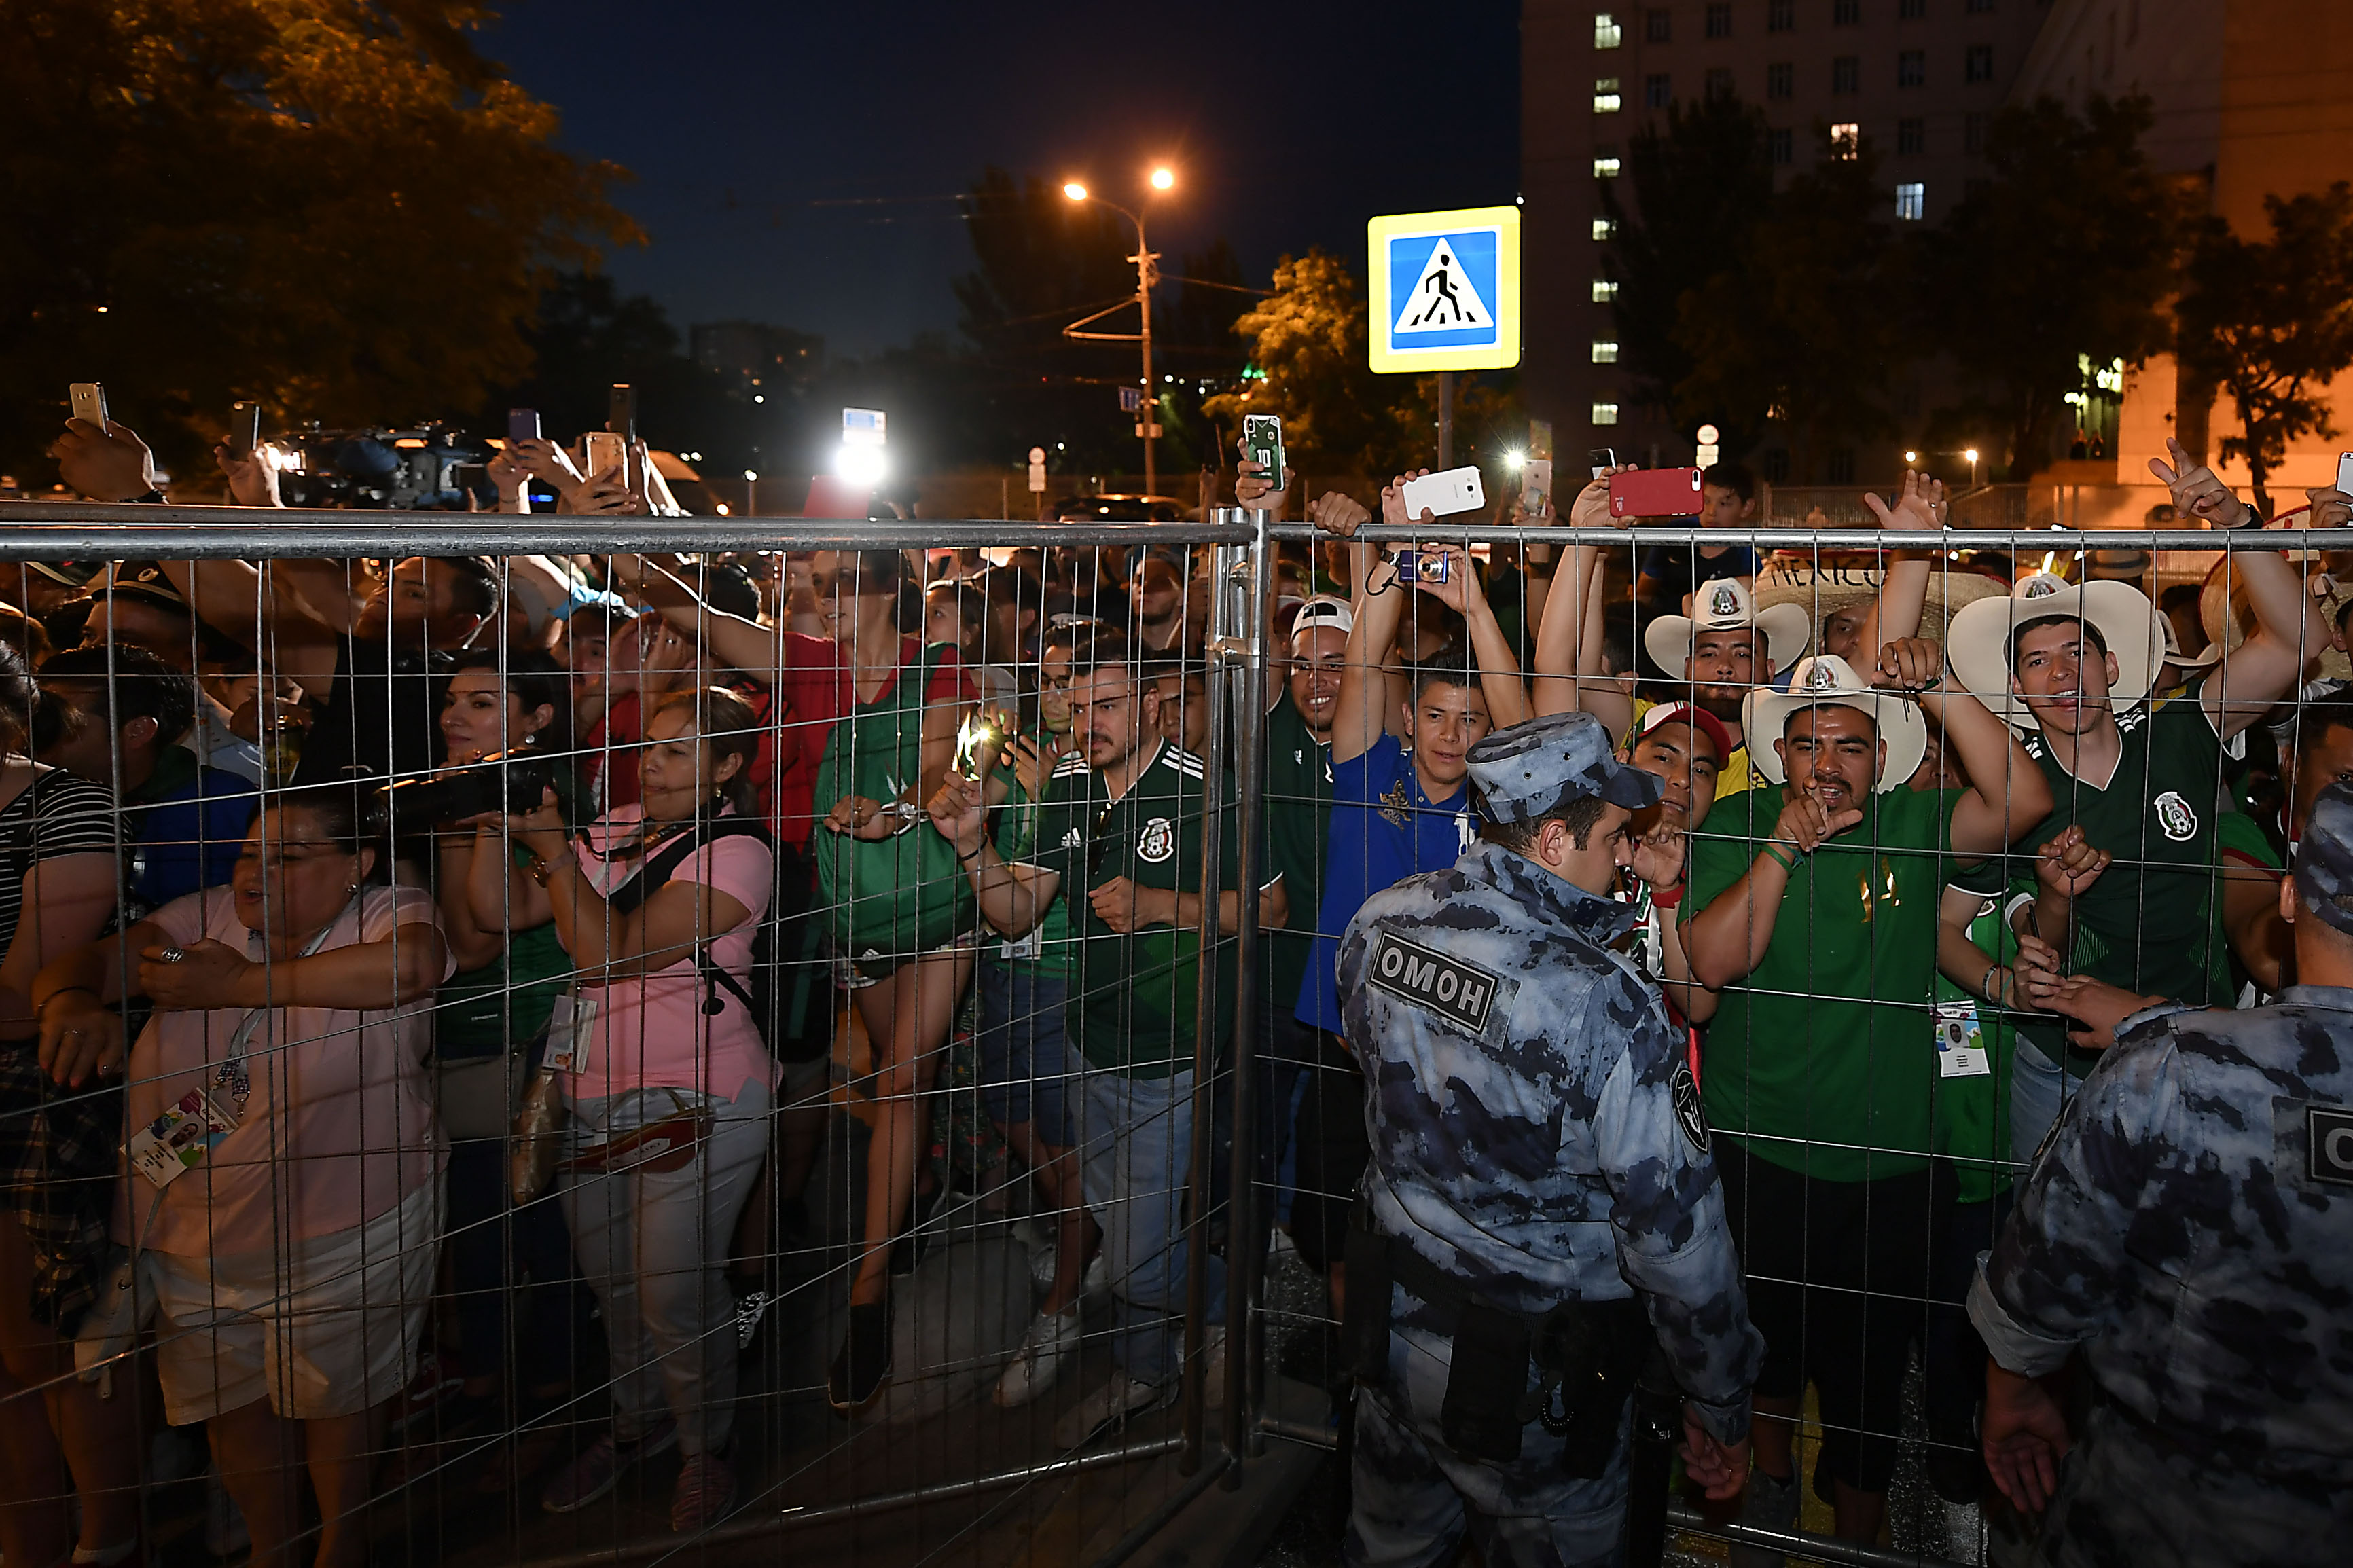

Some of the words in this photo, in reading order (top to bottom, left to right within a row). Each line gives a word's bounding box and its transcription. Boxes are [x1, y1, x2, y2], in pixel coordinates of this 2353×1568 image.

[1257, 449, 1271, 467] 10
[1772, 558, 1888, 588] MEXICO
[1381, 947, 1485, 1017] ОМОН
